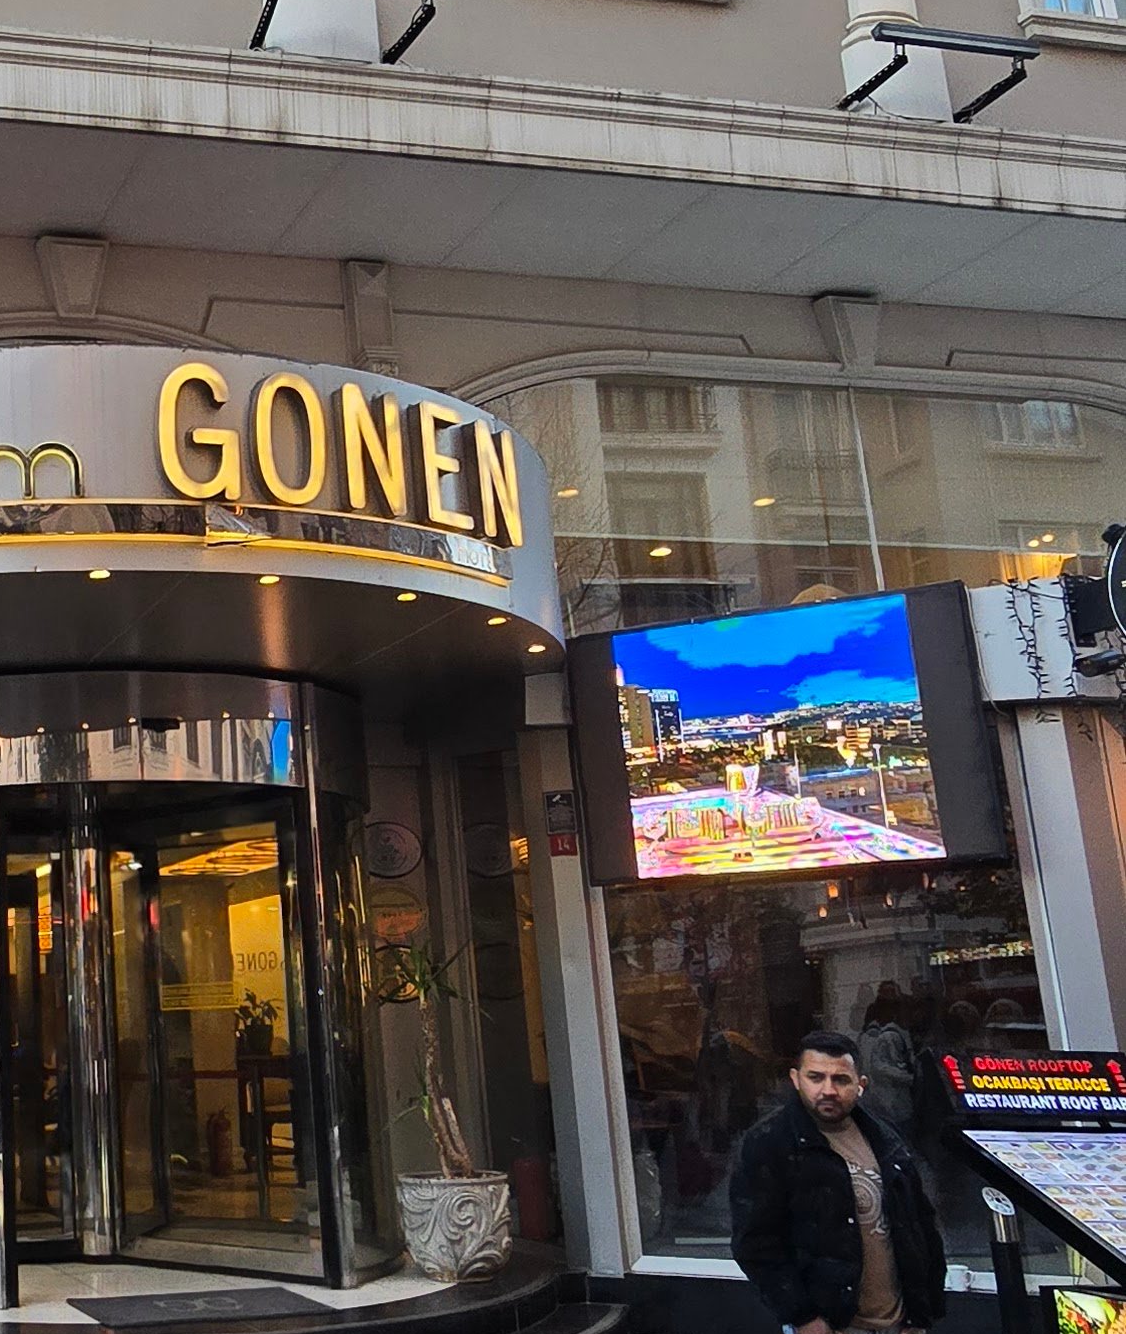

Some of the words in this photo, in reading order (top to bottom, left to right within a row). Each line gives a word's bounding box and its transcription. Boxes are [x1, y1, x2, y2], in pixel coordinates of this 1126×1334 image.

[158, 361, 524, 547] GONEN
[974, 1054, 1024, 1071] GÖNEN
[1027, 1058, 1093, 1073] ROOFTOP
[972, 1075, 1046, 1093] OCAKBAŞI
[1045, 1077, 1111, 1092] TERACCE
[964, 1093, 1058, 1109] RESTAURANT
[1059, 1096, 1100, 1110] ROOF
